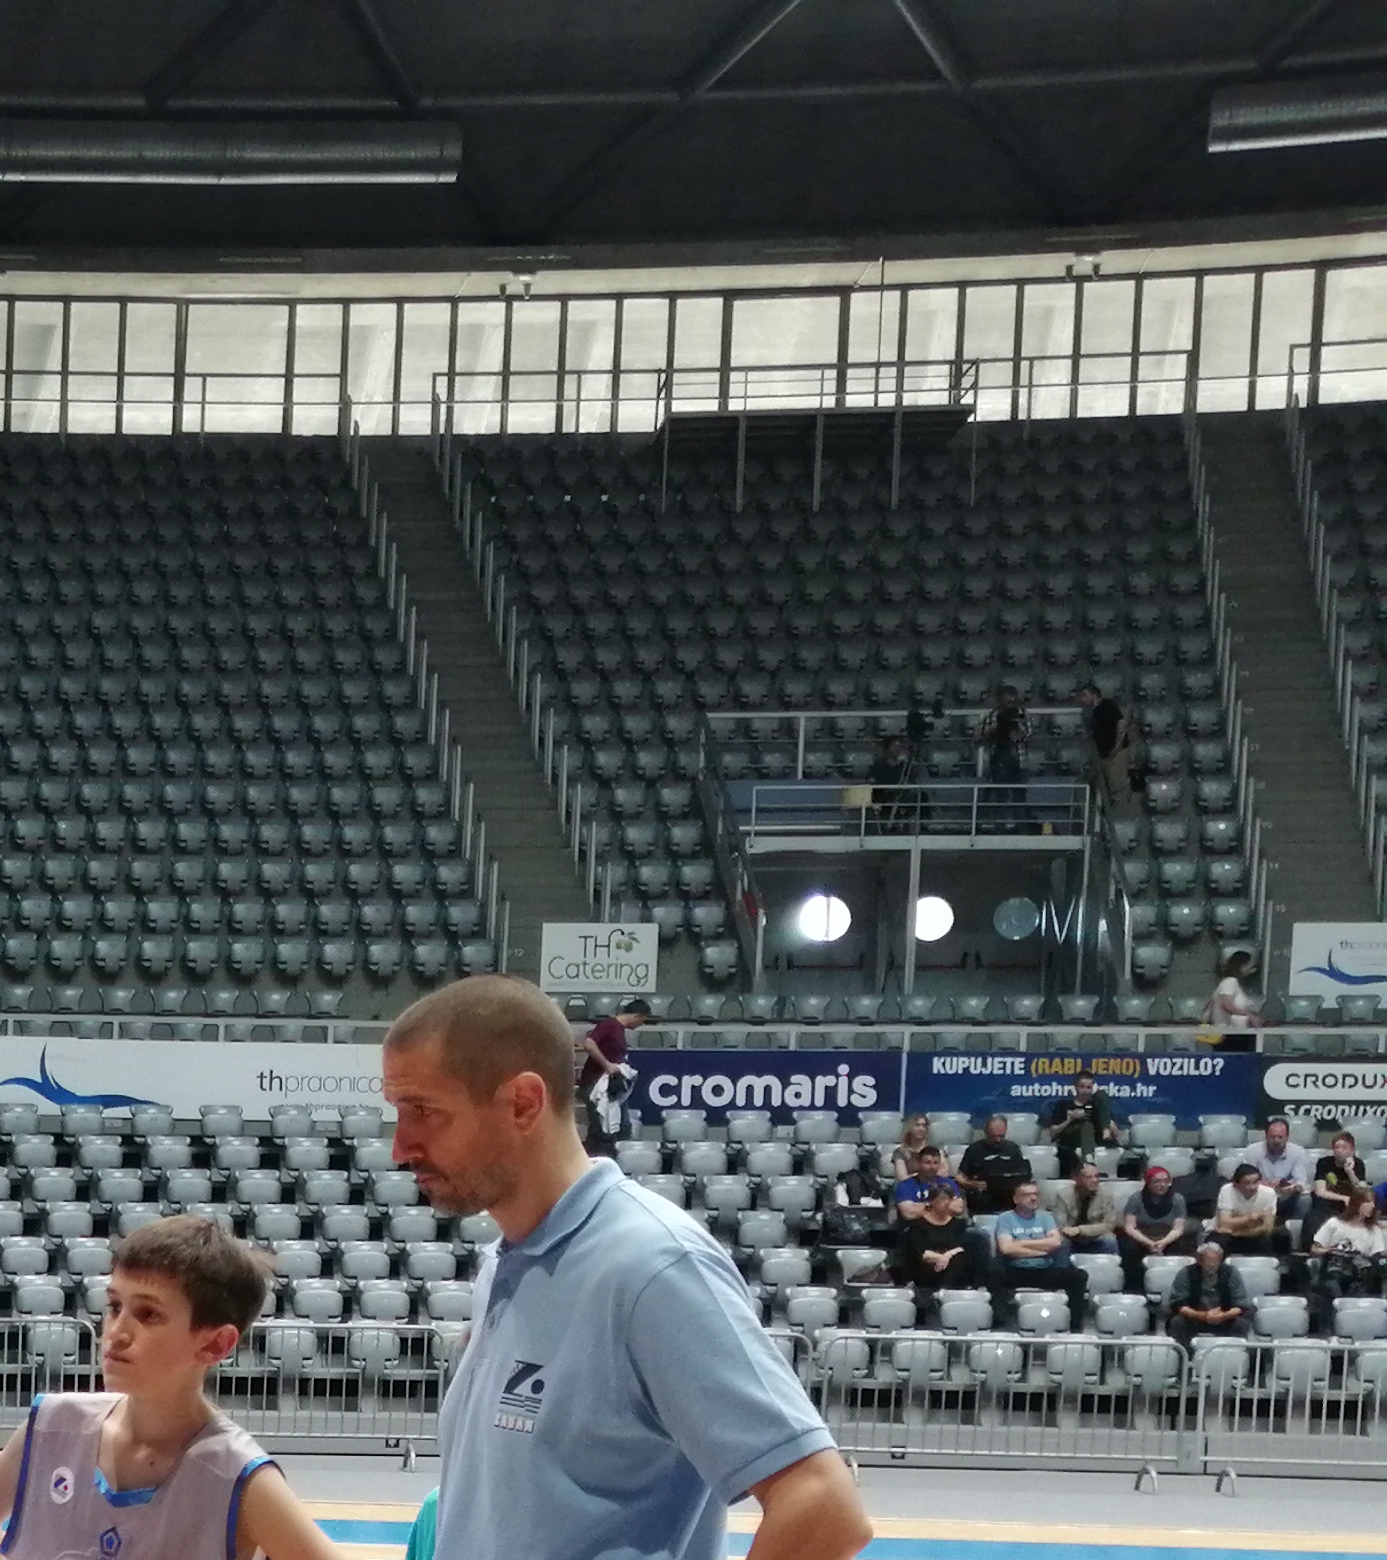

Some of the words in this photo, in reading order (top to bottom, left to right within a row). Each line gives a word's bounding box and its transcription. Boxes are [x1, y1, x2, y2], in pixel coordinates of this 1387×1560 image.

[547, 955, 650, 988] Catering
[932, 1056, 1026, 1076] KUPUJETE
[1146, 1056, 1225, 1077] VOZILO?
[648, 1063, 878, 1108] cromaris
